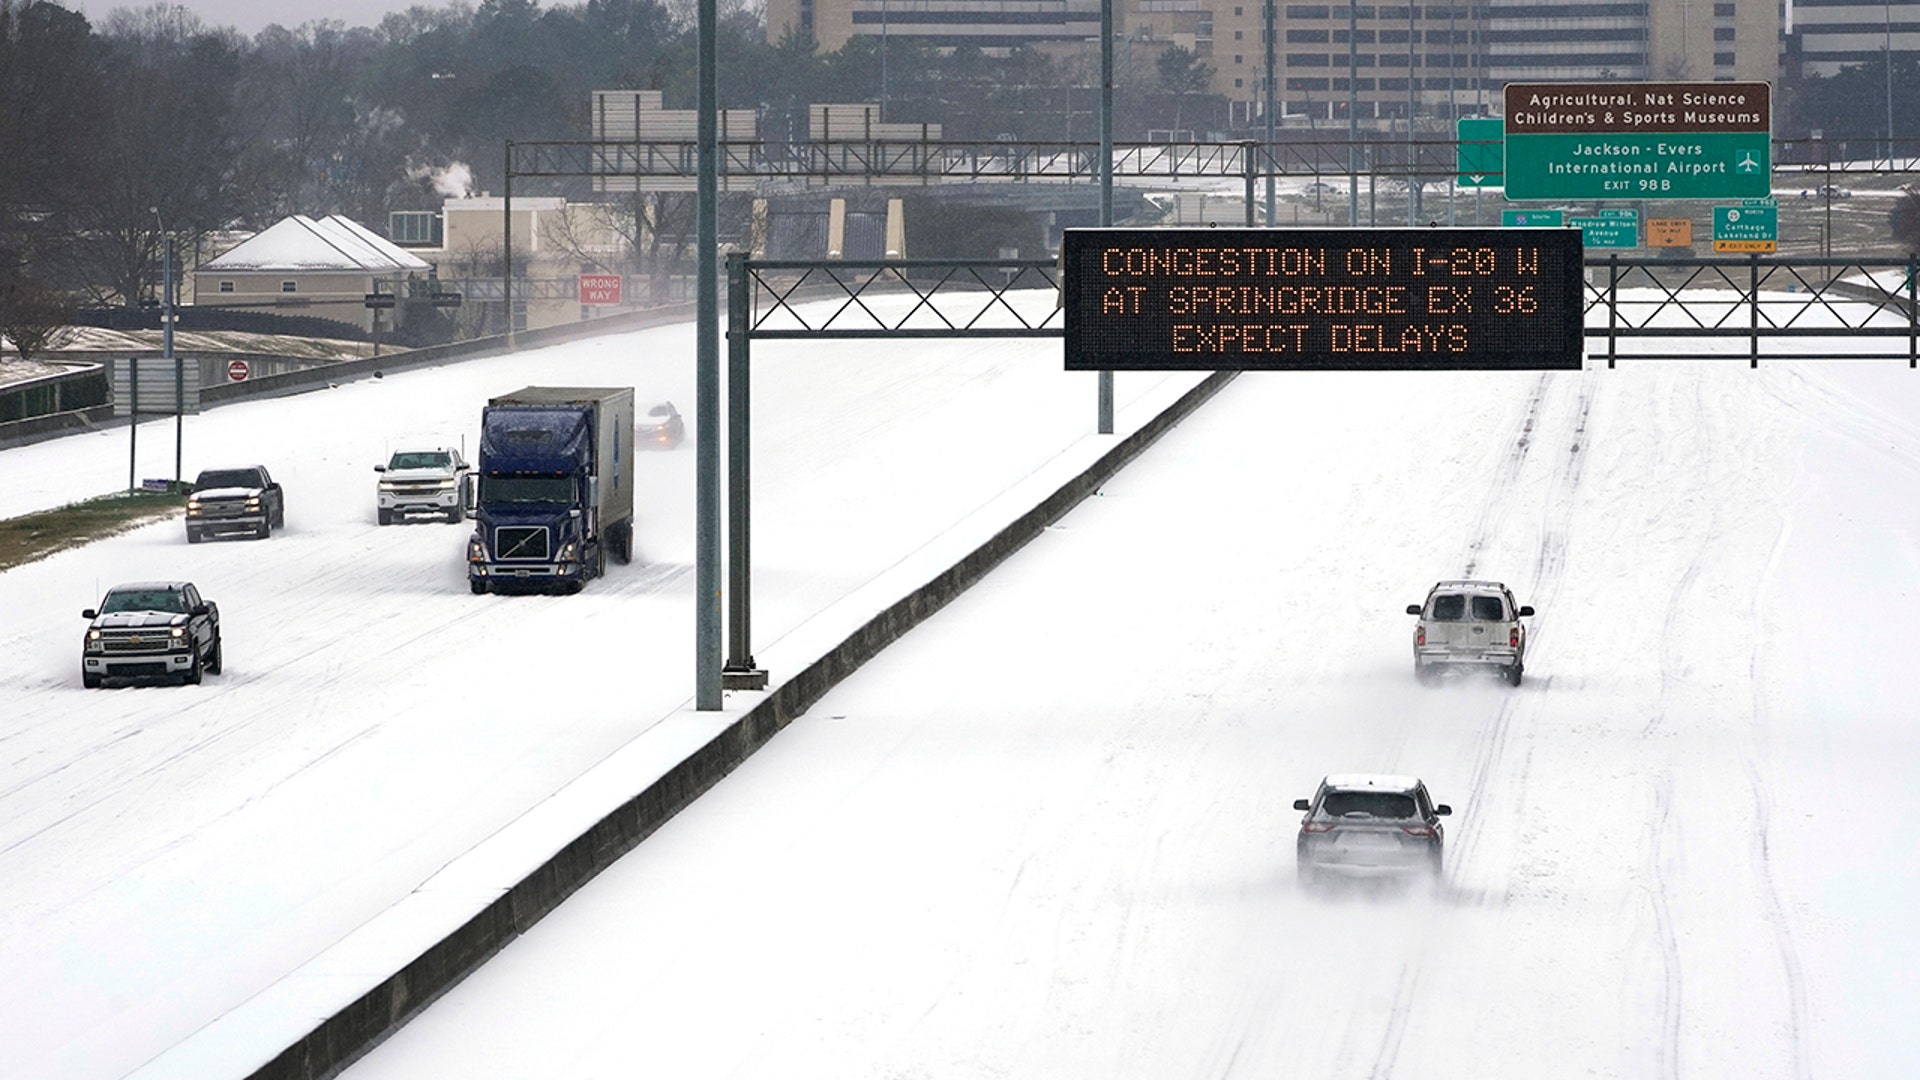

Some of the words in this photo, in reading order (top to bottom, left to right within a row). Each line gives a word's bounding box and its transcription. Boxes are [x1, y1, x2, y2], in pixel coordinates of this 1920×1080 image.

[1645, 94, 1674, 105] Nat
[1682, 93, 1746, 105] Science
[1515, 112, 1595, 125] Children's
[1604, 112, 1614, 124] &
[1623, 112, 1676, 126] Sports
[1684, 112, 1761, 123] Museums
[1573, 143, 1641, 155] Jackson
[1658, 144, 1702, 155] Evers
[1549, 162, 1658, 174] International
[1667, 162, 1726, 175] Airport
[1604, 181, 1630, 190] EXIT
[1102, 247, 1325, 277] CONGESTION
[1346, 247, 1390, 277] ON
[1413, 247, 1495, 277] I-20
[1517, 247, 1538, 277] W
[582, 279, 618, 288] WRONG
[589, 291, 611, 300] WAY
[1102, 286, 1146, 315] AT
[1169, 285, 1407, 315] SPRINGRIDGE
[1428, 285, 1473, 315] EX
[1494, 285, 1538, 315] 36
[1172, 324, 1310, 352] EXPECT
[1331, 324, 1469, 352] DELAYS
